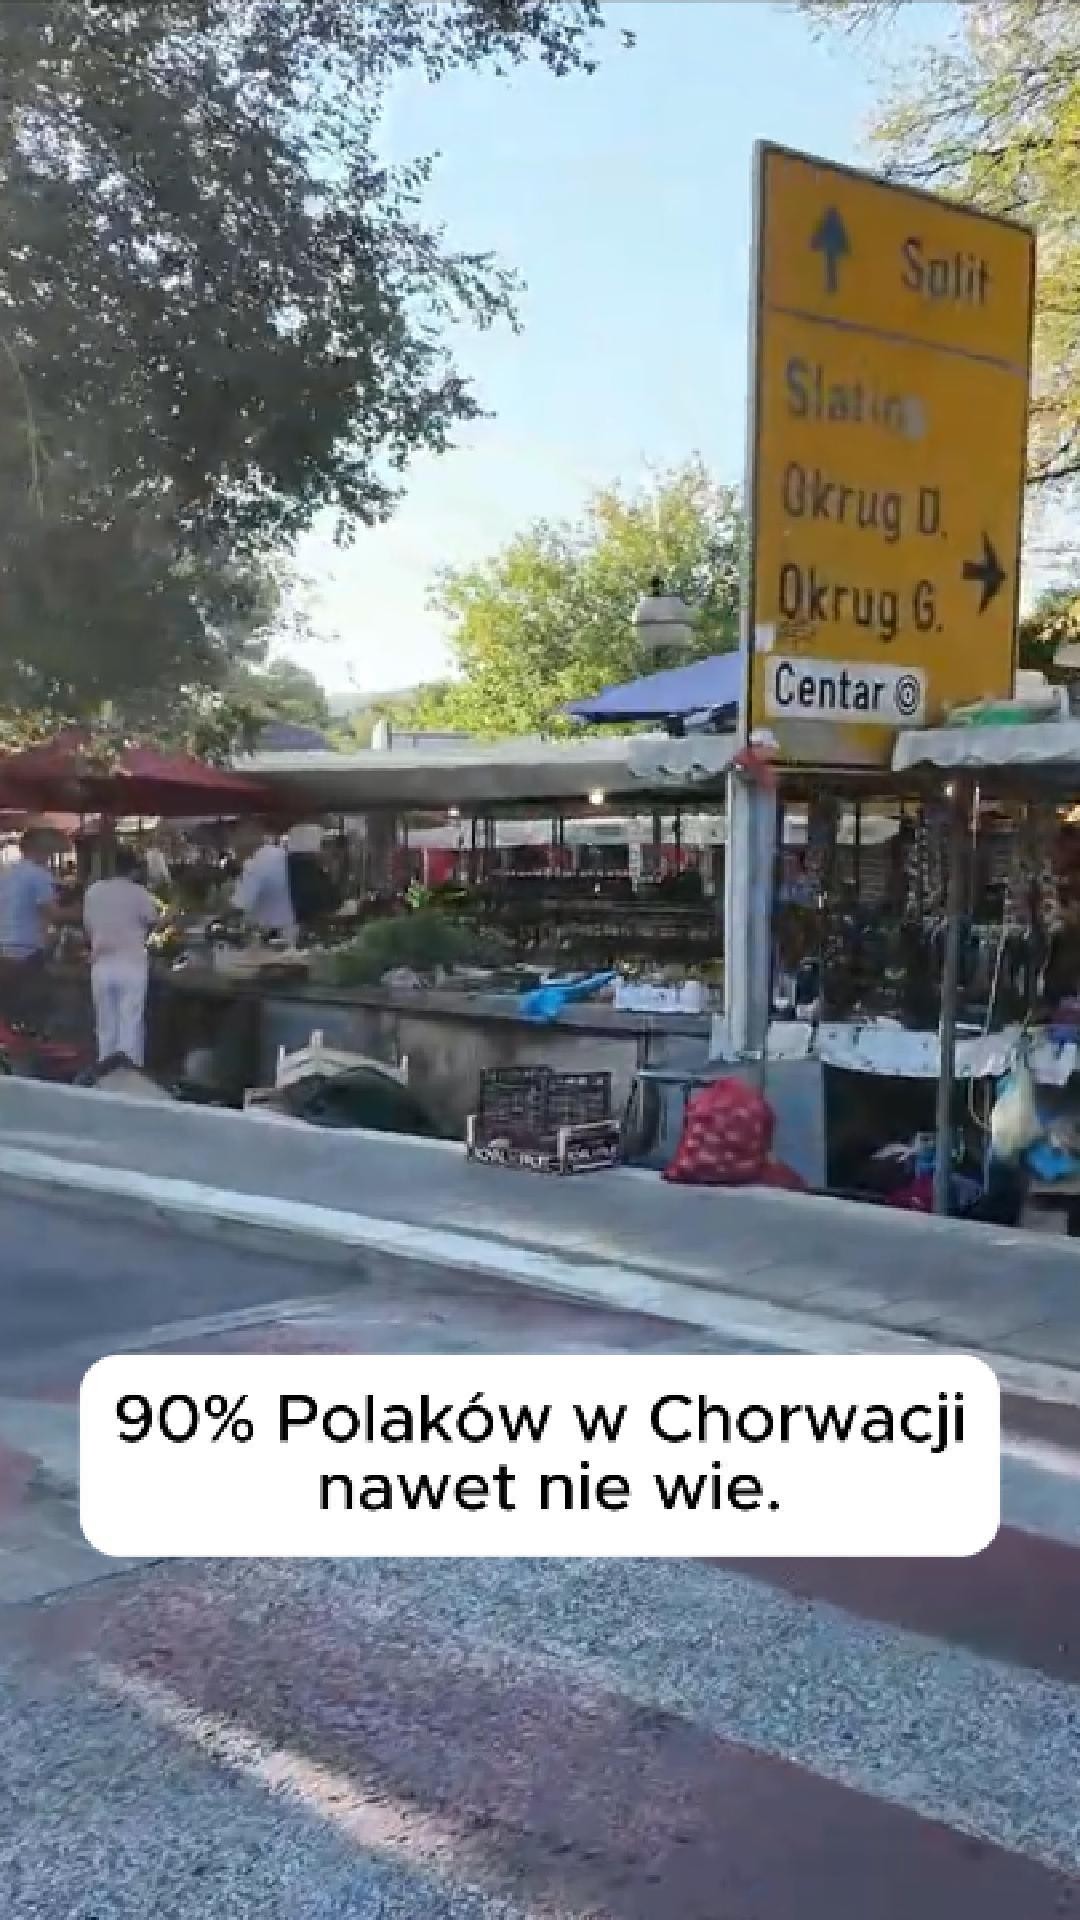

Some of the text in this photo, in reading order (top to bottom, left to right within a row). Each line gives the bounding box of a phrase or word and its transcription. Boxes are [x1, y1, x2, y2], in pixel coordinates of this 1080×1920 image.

[901, 236, 990, 308] Split
[784, 355, 927, 440] Slatin
[783, 461, 948, 544] Okrug D.
[779, 562, 944, 642] Okrug G.
[774, 660, 886, 711] Centar
